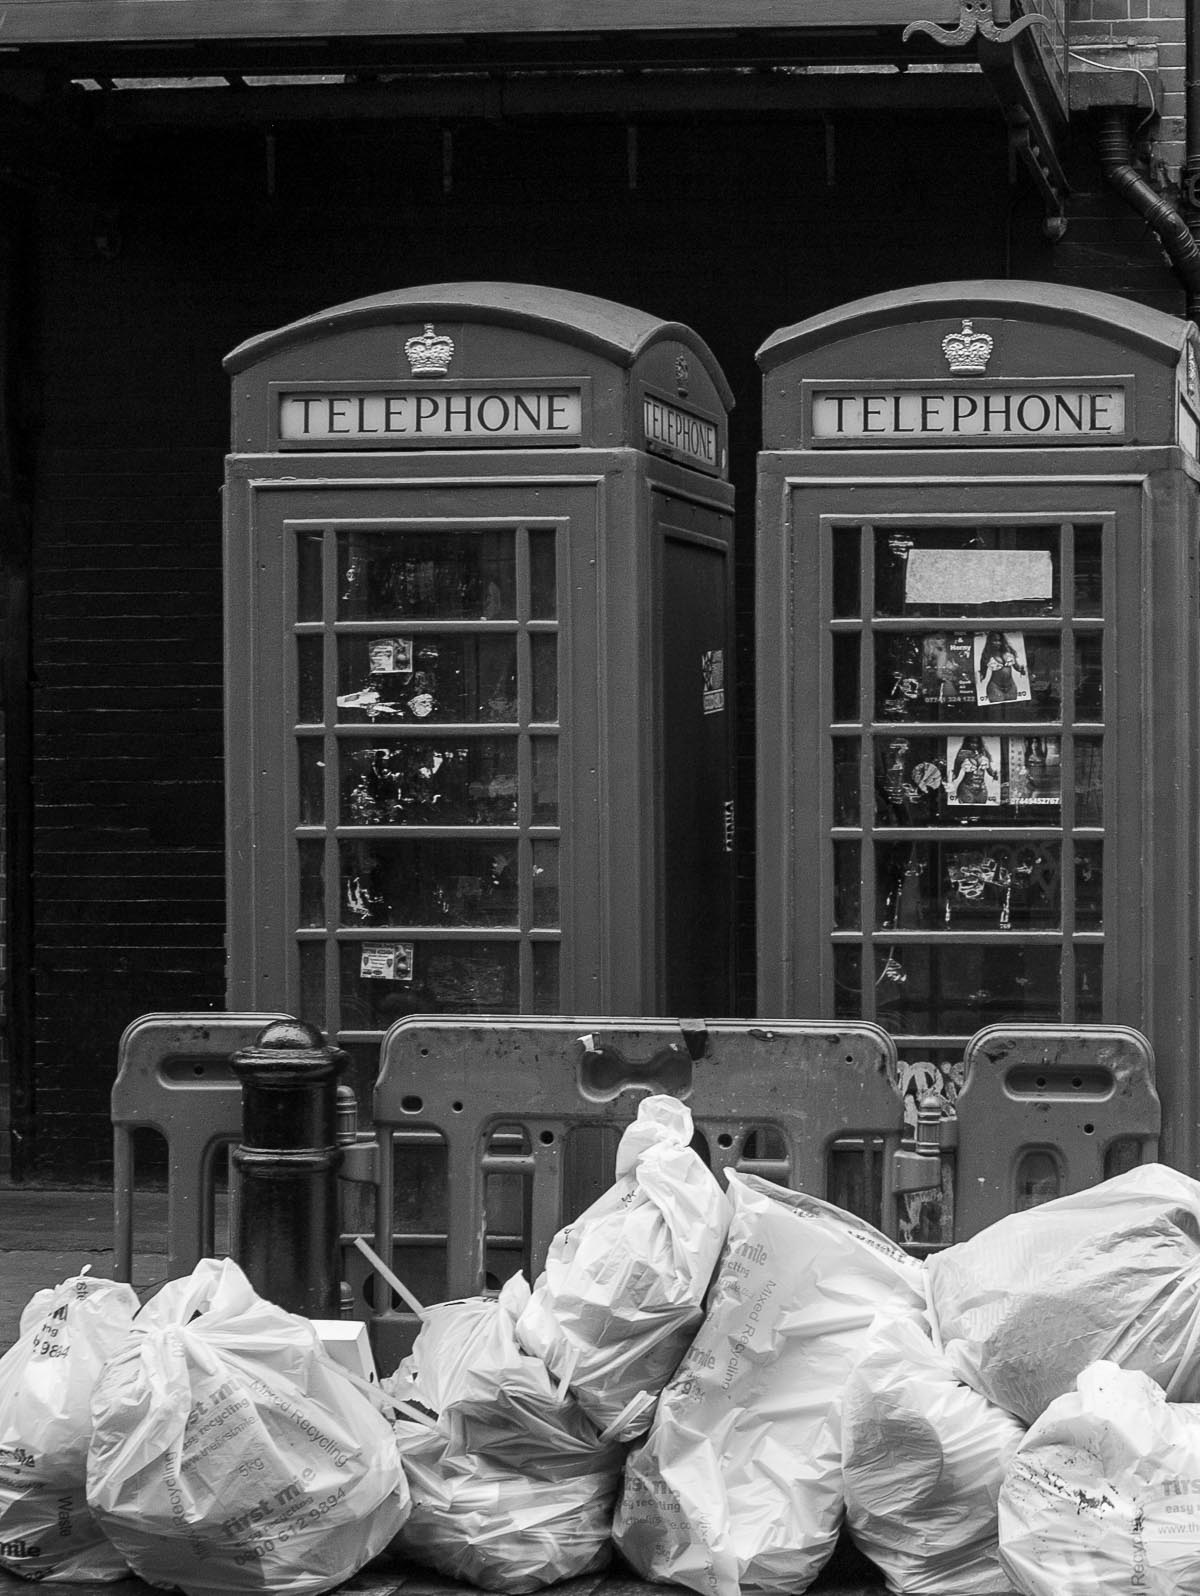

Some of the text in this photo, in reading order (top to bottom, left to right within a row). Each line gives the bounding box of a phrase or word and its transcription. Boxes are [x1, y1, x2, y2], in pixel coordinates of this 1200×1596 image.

[291, 394, 571, 434] TELEPHONE
[644, 399, 713, 461] TELEPHONE
[824, 394, 1113, 433] TELEPHONE
[748, 1279, 777, 1322] Mixed
[289, 1408, 351, 1469] Recycling
[221, 1499, 275, 1538] first
[309, 1486, 347, 1521] 9894
[1164, 1503, 1195, 1515] easy
